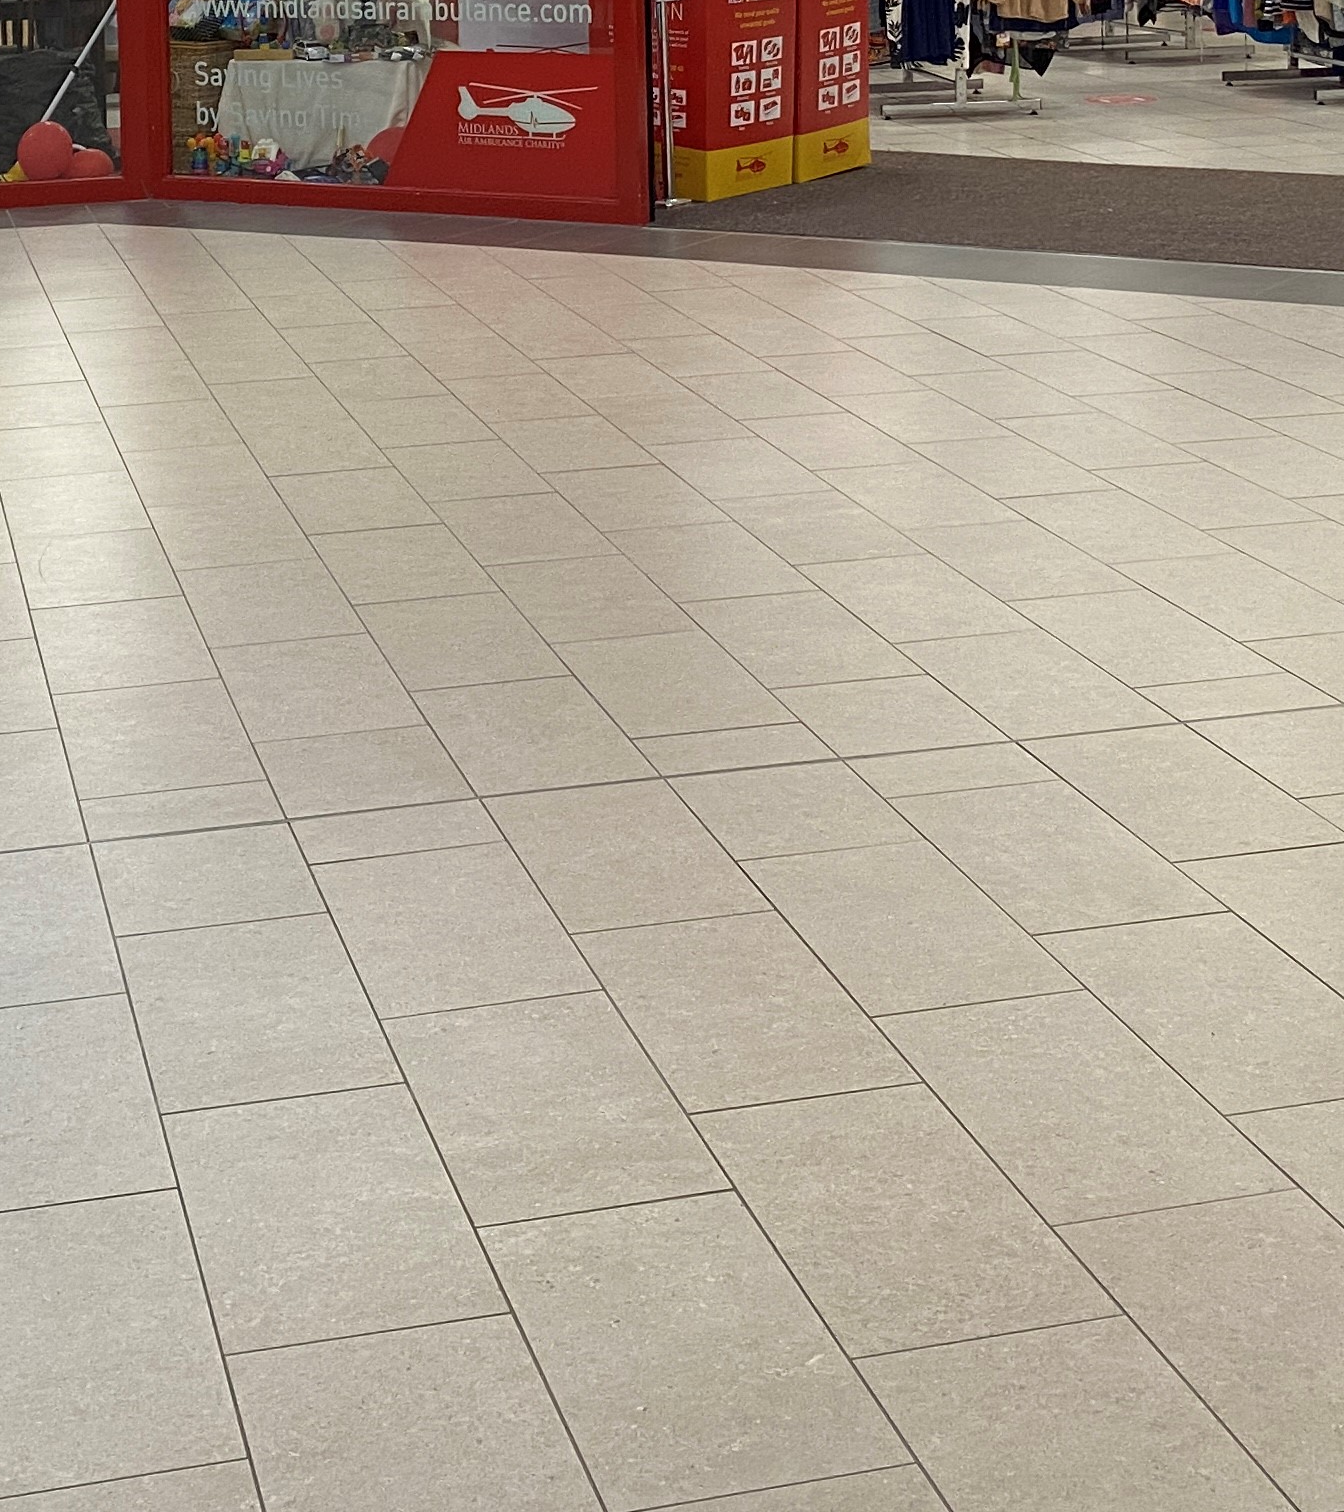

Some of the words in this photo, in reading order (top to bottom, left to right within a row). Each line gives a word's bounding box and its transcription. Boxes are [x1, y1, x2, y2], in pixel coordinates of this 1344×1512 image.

[195, 61, 272, 93] Saving
[282, 63, 343, 89] Lives
[196, 101, 219, 132] by
[230, 101, 307, 130] Saving
[458, 121, 520, 136] MIDLANDS
[474, 137, 524, 148] AMBULANCE
